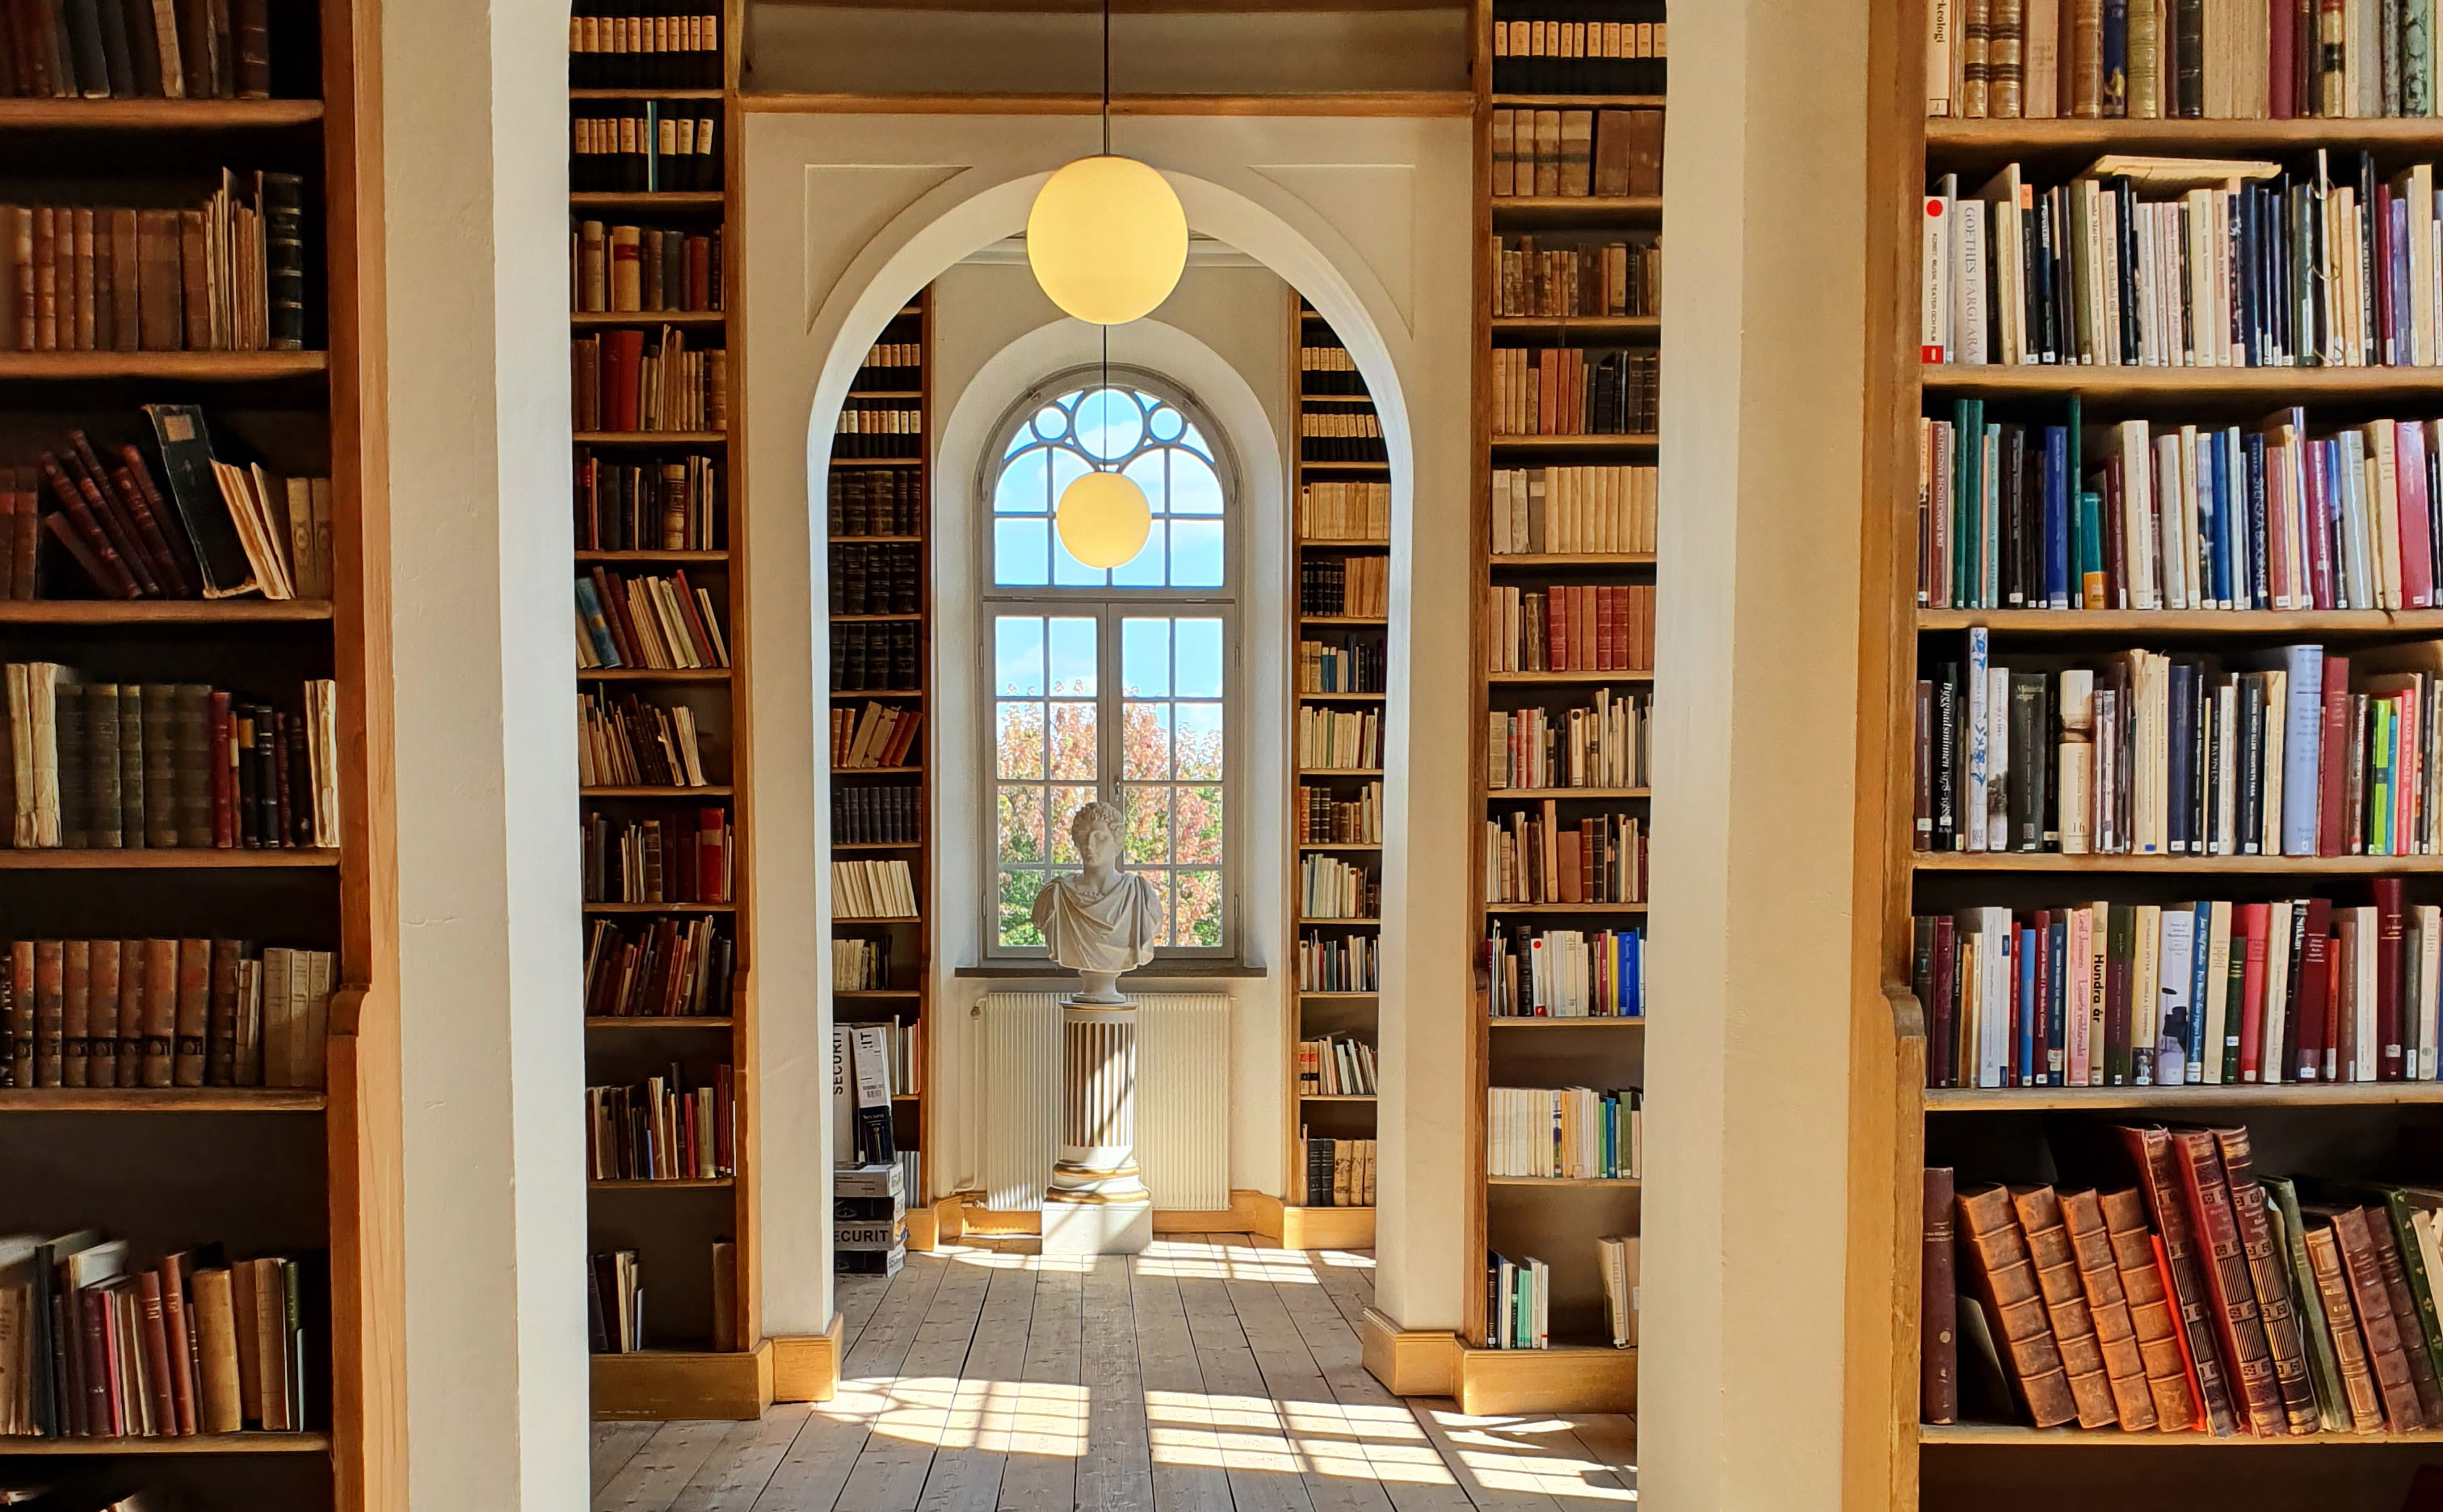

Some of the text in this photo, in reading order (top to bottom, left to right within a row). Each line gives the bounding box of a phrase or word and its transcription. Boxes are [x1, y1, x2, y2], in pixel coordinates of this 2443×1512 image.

[1933, 0, 1948, 44] keologi
[1963, 207, 1977, 273] GOETHES
[2253, 477, 2265, 527] SVENSKA
[1939, 682, 1953, 767] Byggnadsminnen
[2078, 914, 2088, 933] Leif
[2198, 916, 2208, 929] Jan
[2294, 917, 2305, 950] Stikkan
[2092, 954, 2105, 1023] Hundra år
[860, 1031, 873, 1049] IT
